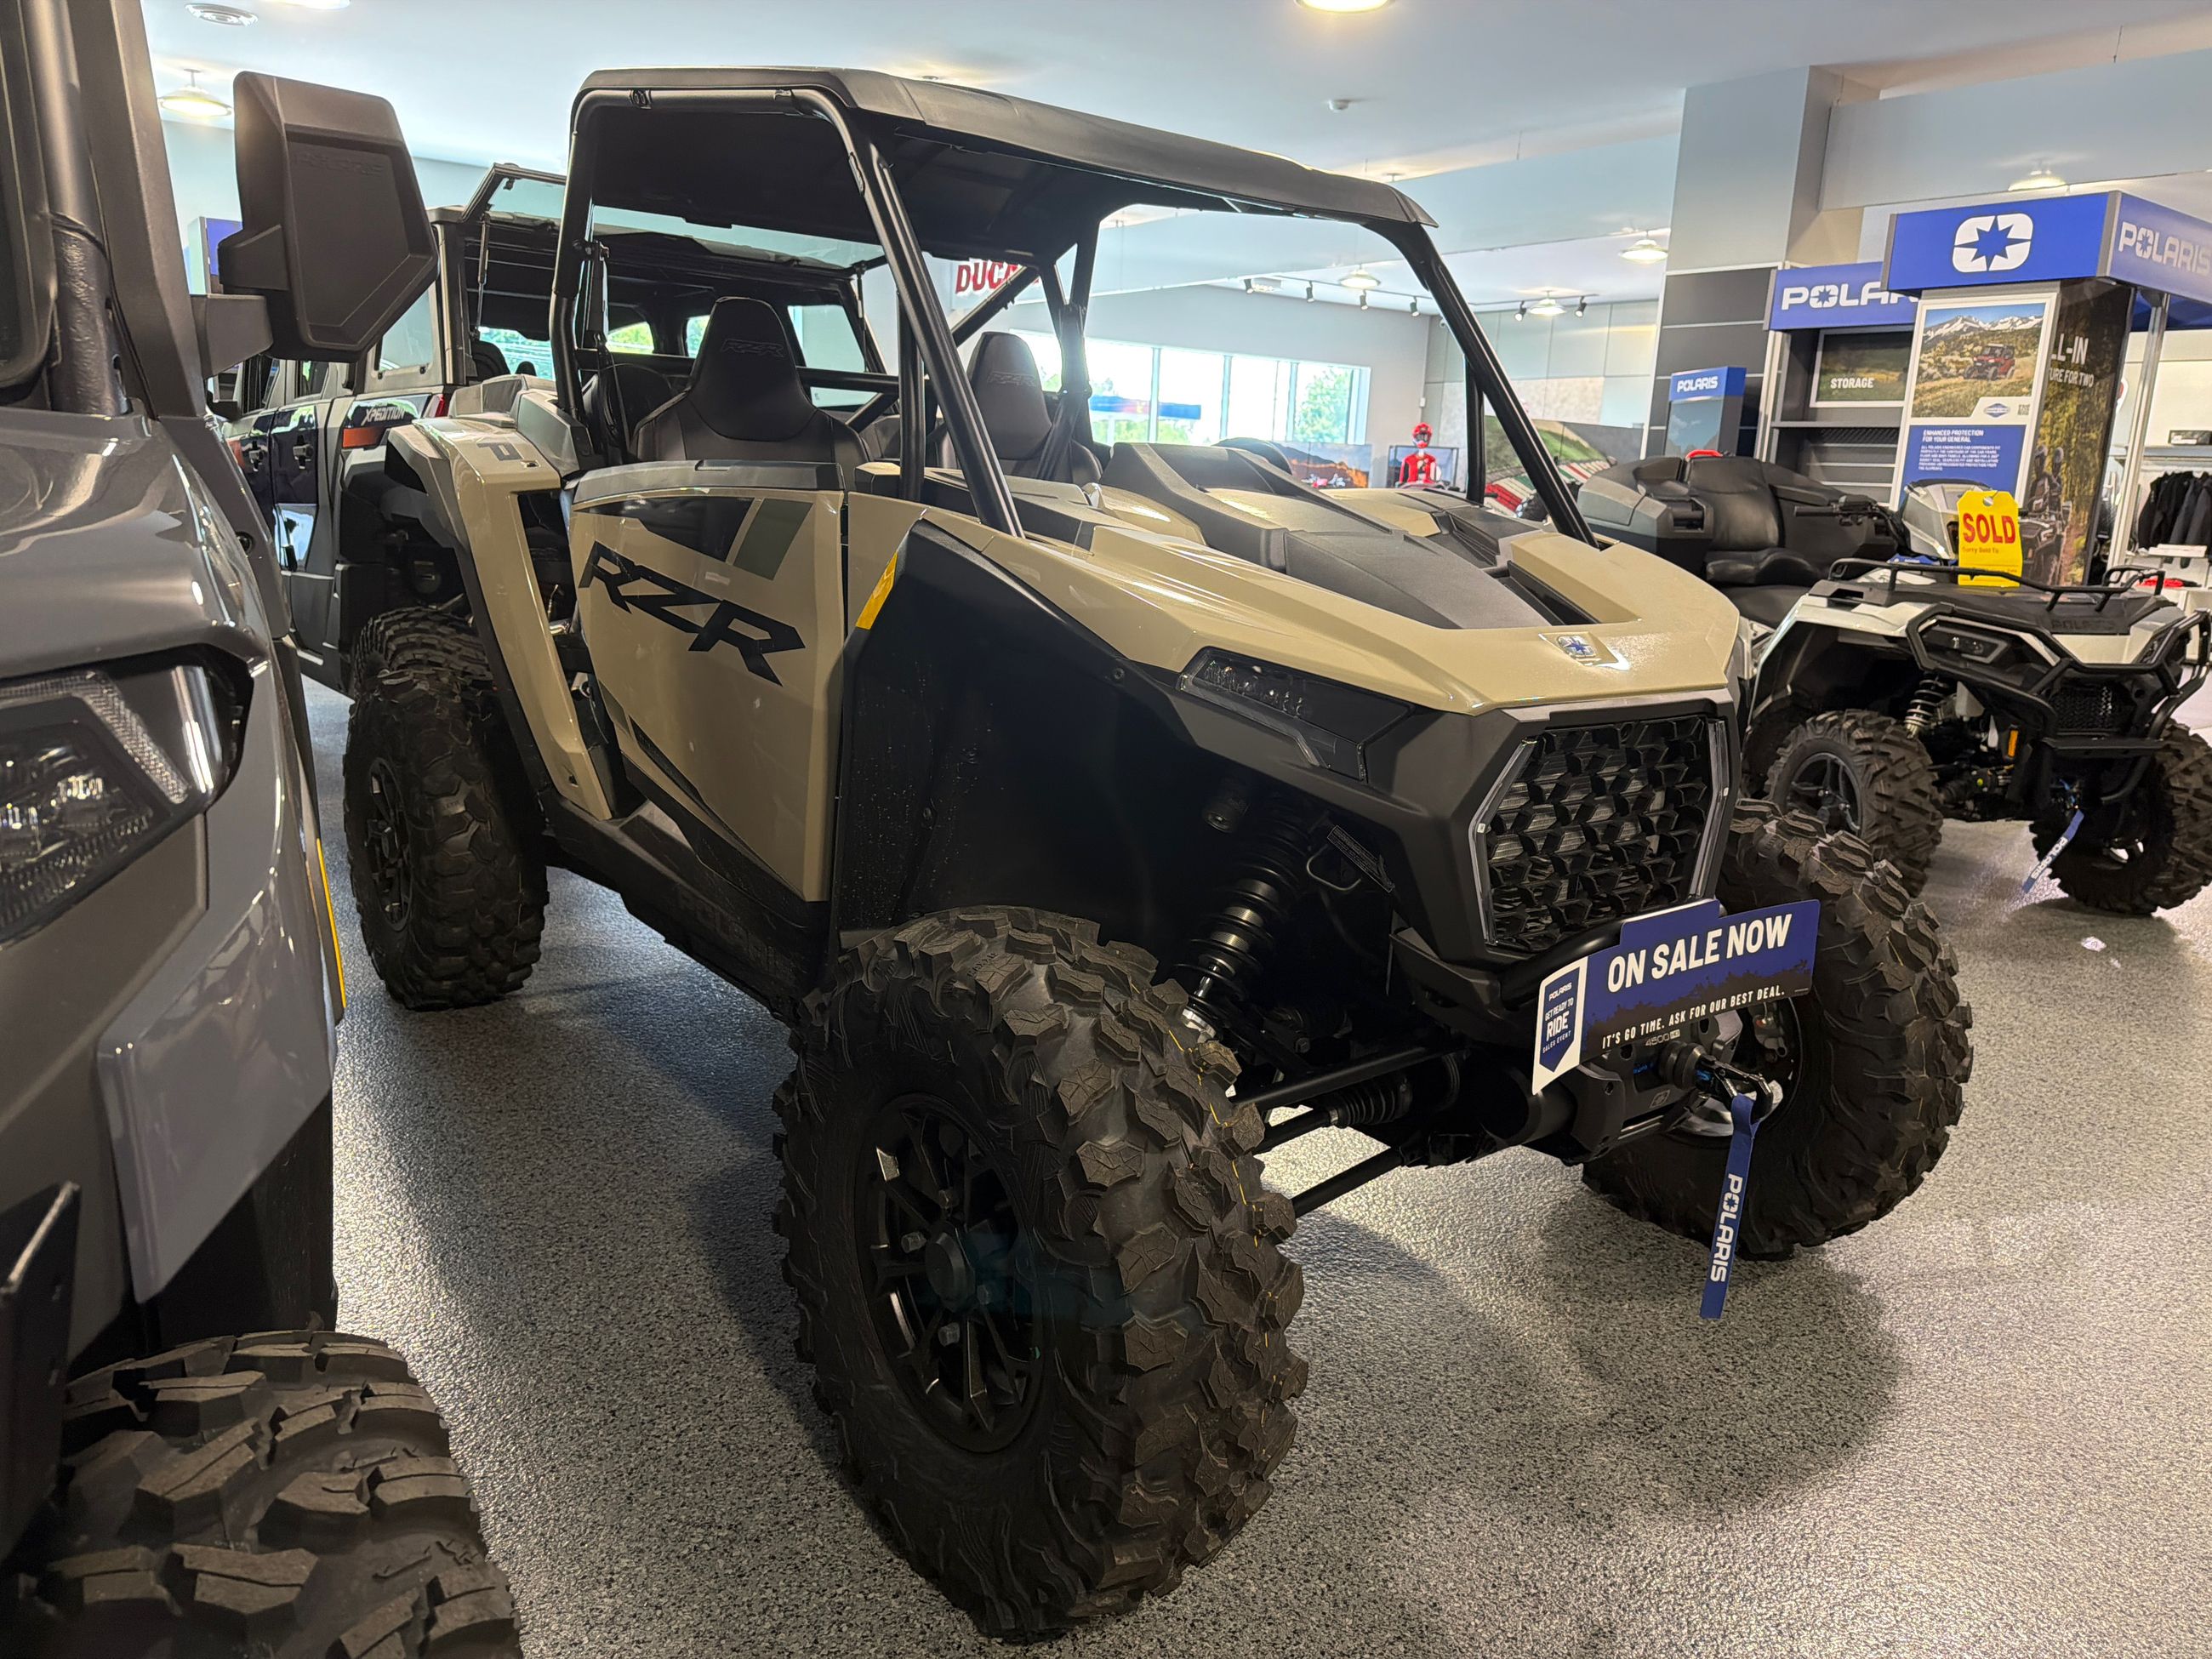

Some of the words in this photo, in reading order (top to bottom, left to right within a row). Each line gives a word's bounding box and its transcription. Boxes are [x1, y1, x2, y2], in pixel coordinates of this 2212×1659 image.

[2118, 221, 2211, 276] POLARIS
[1677, 376, 1719, 392] POLARIS
[1830, 377, 1875, 389] STORAGE
[2064, 369, 2078, 385] FOR
[2079, 372, 2095, 387] TWO
[361, 407, 406, 426] XPEDITION
[1963, 513, 2016, 544] SOLD
[579, 540, 806, 687] RZR
[2031, 836, 2068, 880] POLARIS
[1608, 949, 1646, 993] ON
[1651, 928, 1723, 979] SALE
[1726, 913, 1793, 959] NOW
[1548, 982, 1572, 1001] POLARIS
[1545, 1008, 1554, 1022] GET
[1553, 1001, 1567, 1016] READY
[1567, 997, 1574, 1007] TO
[1602, 1031, 1622, 1049] IT'S
[1624, 1026, 1636, 1041] GO
[1640, 1018, 1665, 1036] TIME.
[1668, 1011, 1686, 1027] ASK
[1690, 1004, 1707, 1020] FOR
[1709, 999, 1727, 1013] OUR
[1730, 990, 1754, 1008] BEST
[1756, 984, 1785, 1001] DEAL.
[1546, 1011, 1570, 1042] RIDE
[1645, 1035, 1670, 1046] 4500
[1542, 1040, 1556, 1054] SALES
[1556, 1030, 1571, 1044] EVENT
[1710, 1173, 1743, 1282] POLARIS
